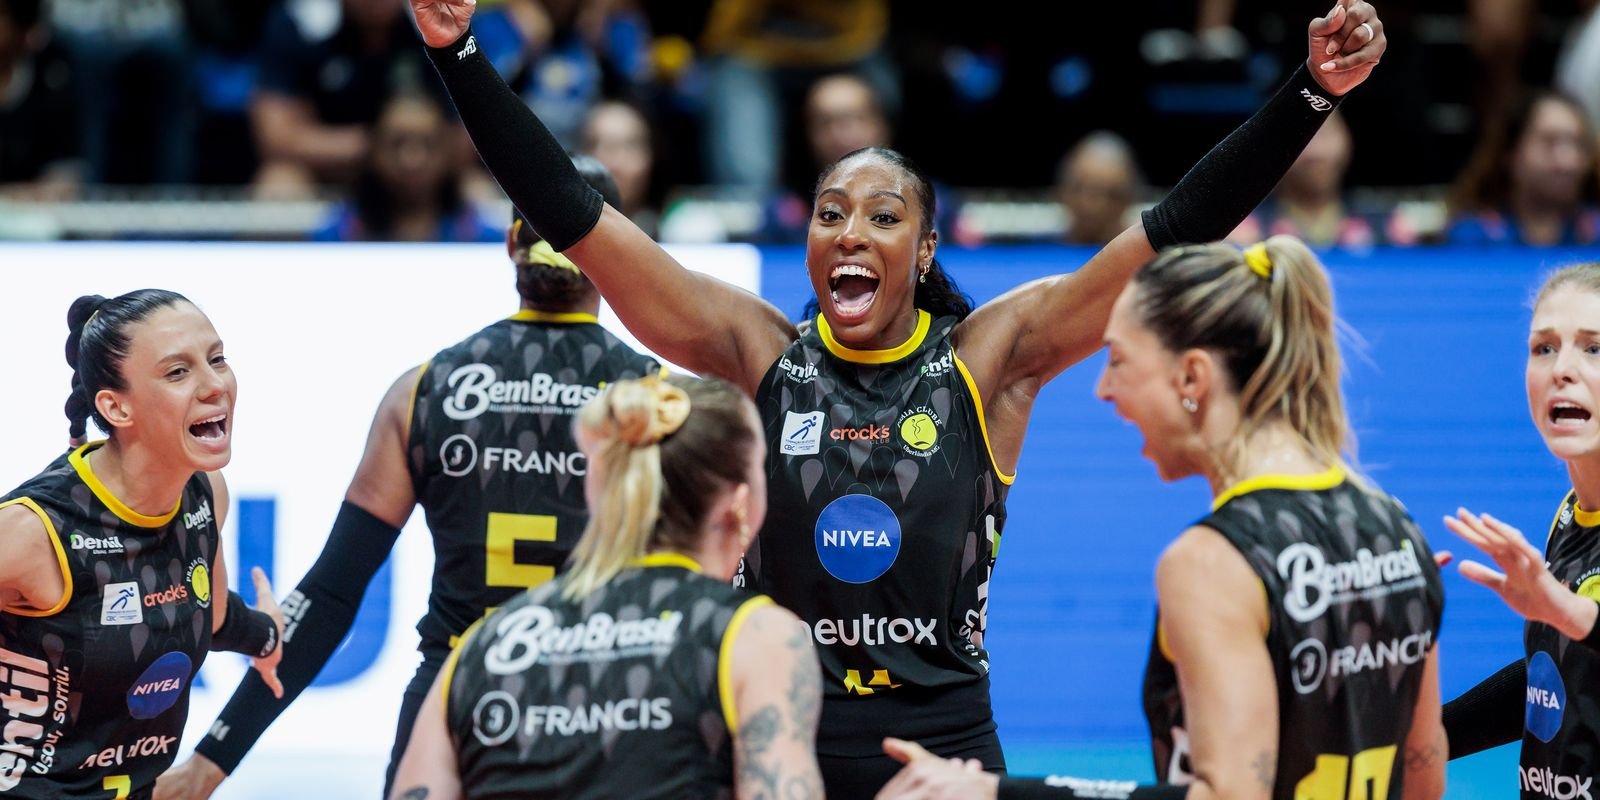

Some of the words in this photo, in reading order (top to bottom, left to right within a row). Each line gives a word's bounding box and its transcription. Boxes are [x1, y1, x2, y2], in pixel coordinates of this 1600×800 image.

[916, 406, 943, 427] CLUBE
[822, 530, 892, 548] NIVEA
[486, 512, 558, 617] 5
[799, 613, 938, 646] neutrox
[53, 665, 70, 725] sorriu.
[133, 678, 181, 696] NIVEA
[524, 697, 673, 737] FRANCIS
